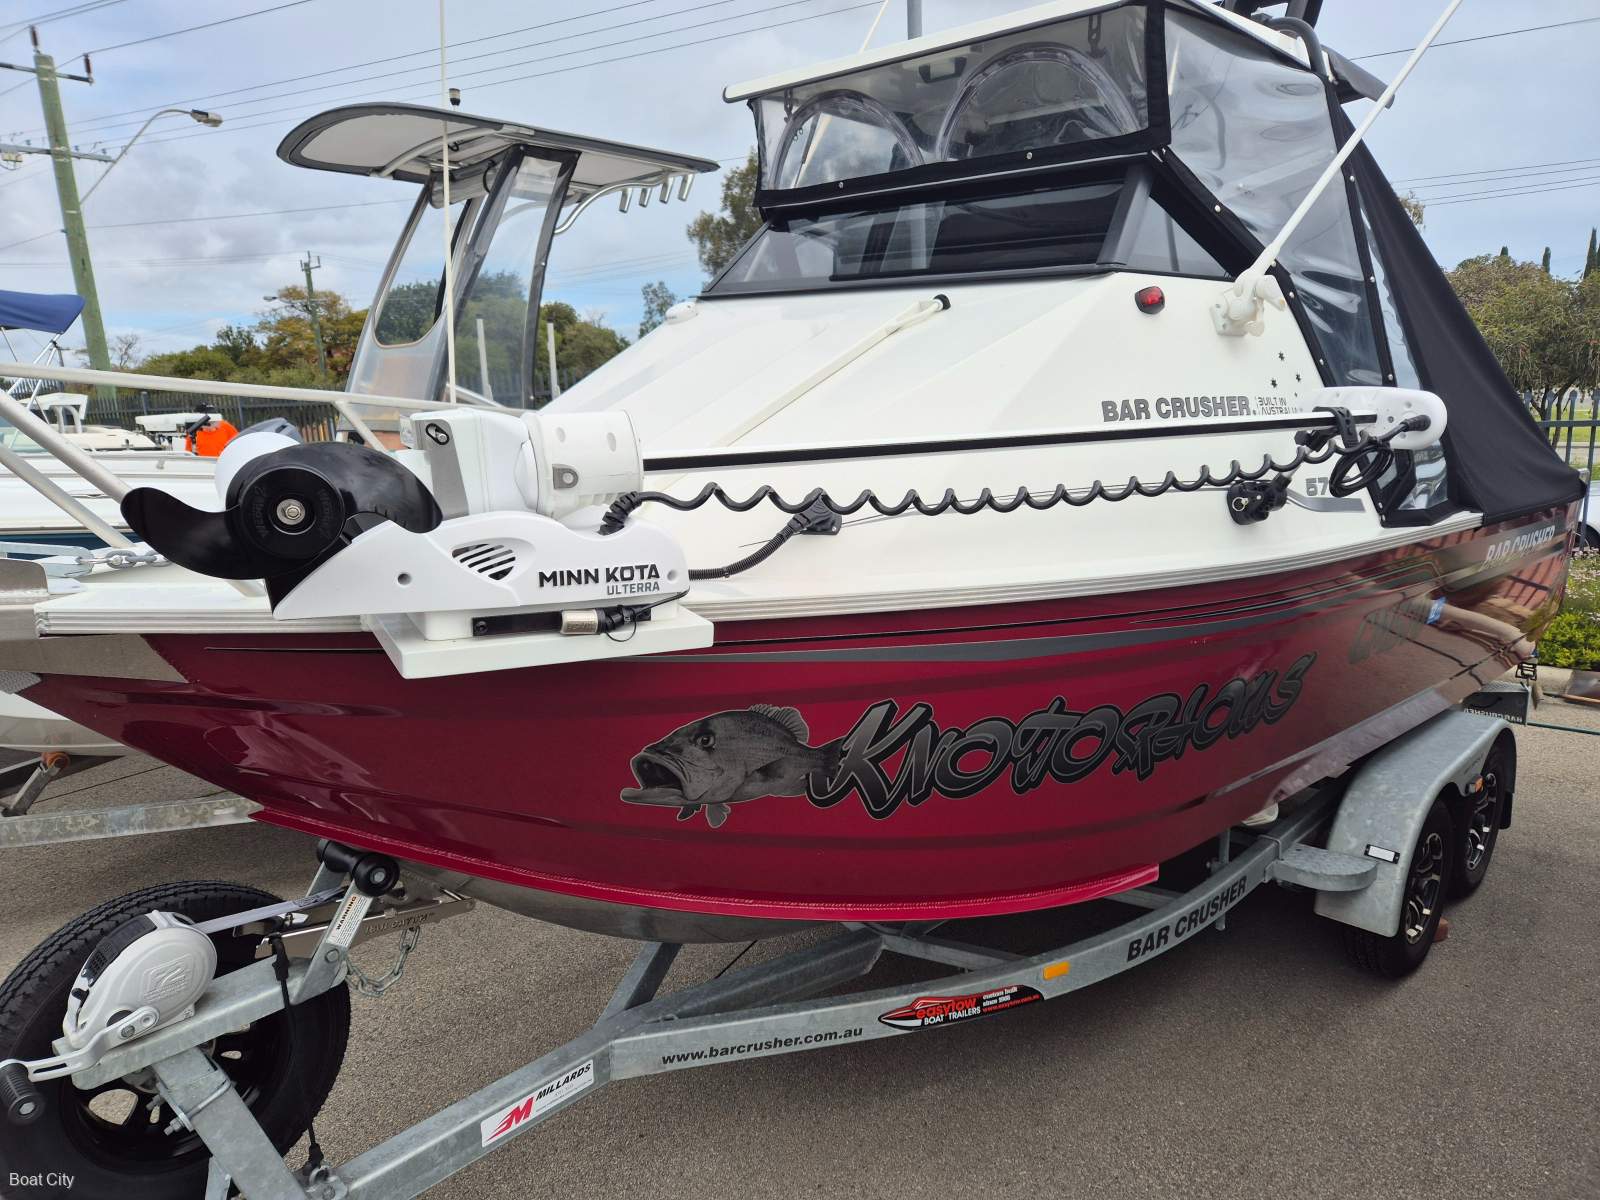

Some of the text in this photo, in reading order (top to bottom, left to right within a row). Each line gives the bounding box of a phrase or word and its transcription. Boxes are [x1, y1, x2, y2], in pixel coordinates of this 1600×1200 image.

[1101, 395, 1251, 423] BAR CRUSHER
[538, 563, 661, 588] MINN KOTA
[607, 581, 661, 596] ULTERRA
[336, 895, 358, 931] WARNING
[1126, 875, 1248, 962] BAR CRUSHER
[916, 998, 977, 1019] easytow
[923, 1006, 981, 1026] BOAT TRAILERS
[661, 1027, 864, 1065] www.barcrusher.com.au
[535, 1063, 592, 1102] MILLARDS
